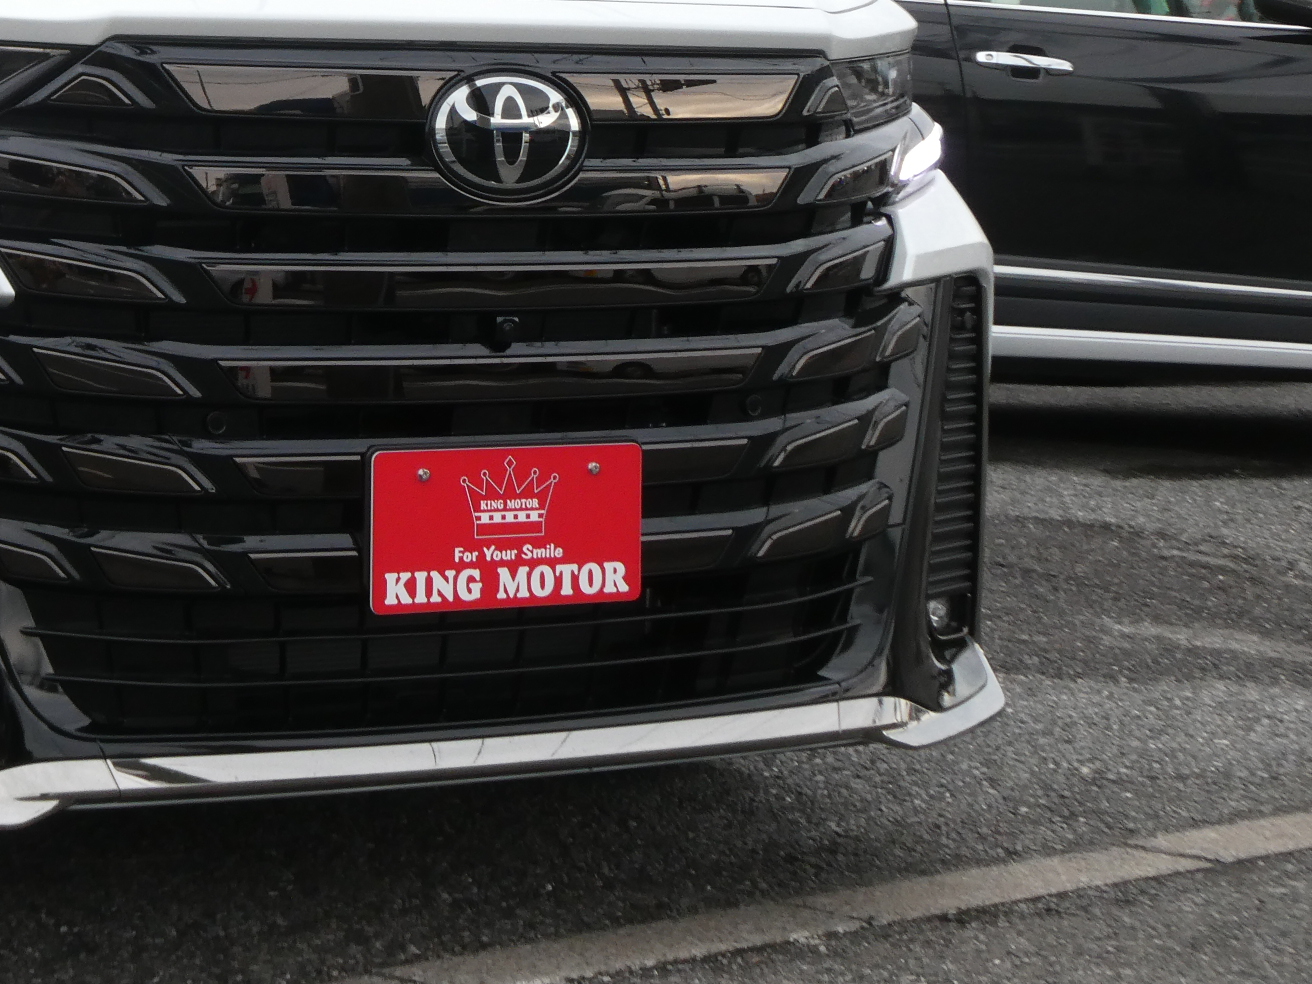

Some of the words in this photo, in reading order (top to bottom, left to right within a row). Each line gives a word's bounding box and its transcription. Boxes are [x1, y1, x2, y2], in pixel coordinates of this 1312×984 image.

[480, 499, 504, 511] KING
[506, 498, 540, 510] MOTOR
[454, 547, 479, 563] For
[483, 545, 518, 562] Your
[521, 542, 564, 560] Smile
[384, 568, 483, 606] KING
[496, 561, 630, 600] MOTOR
